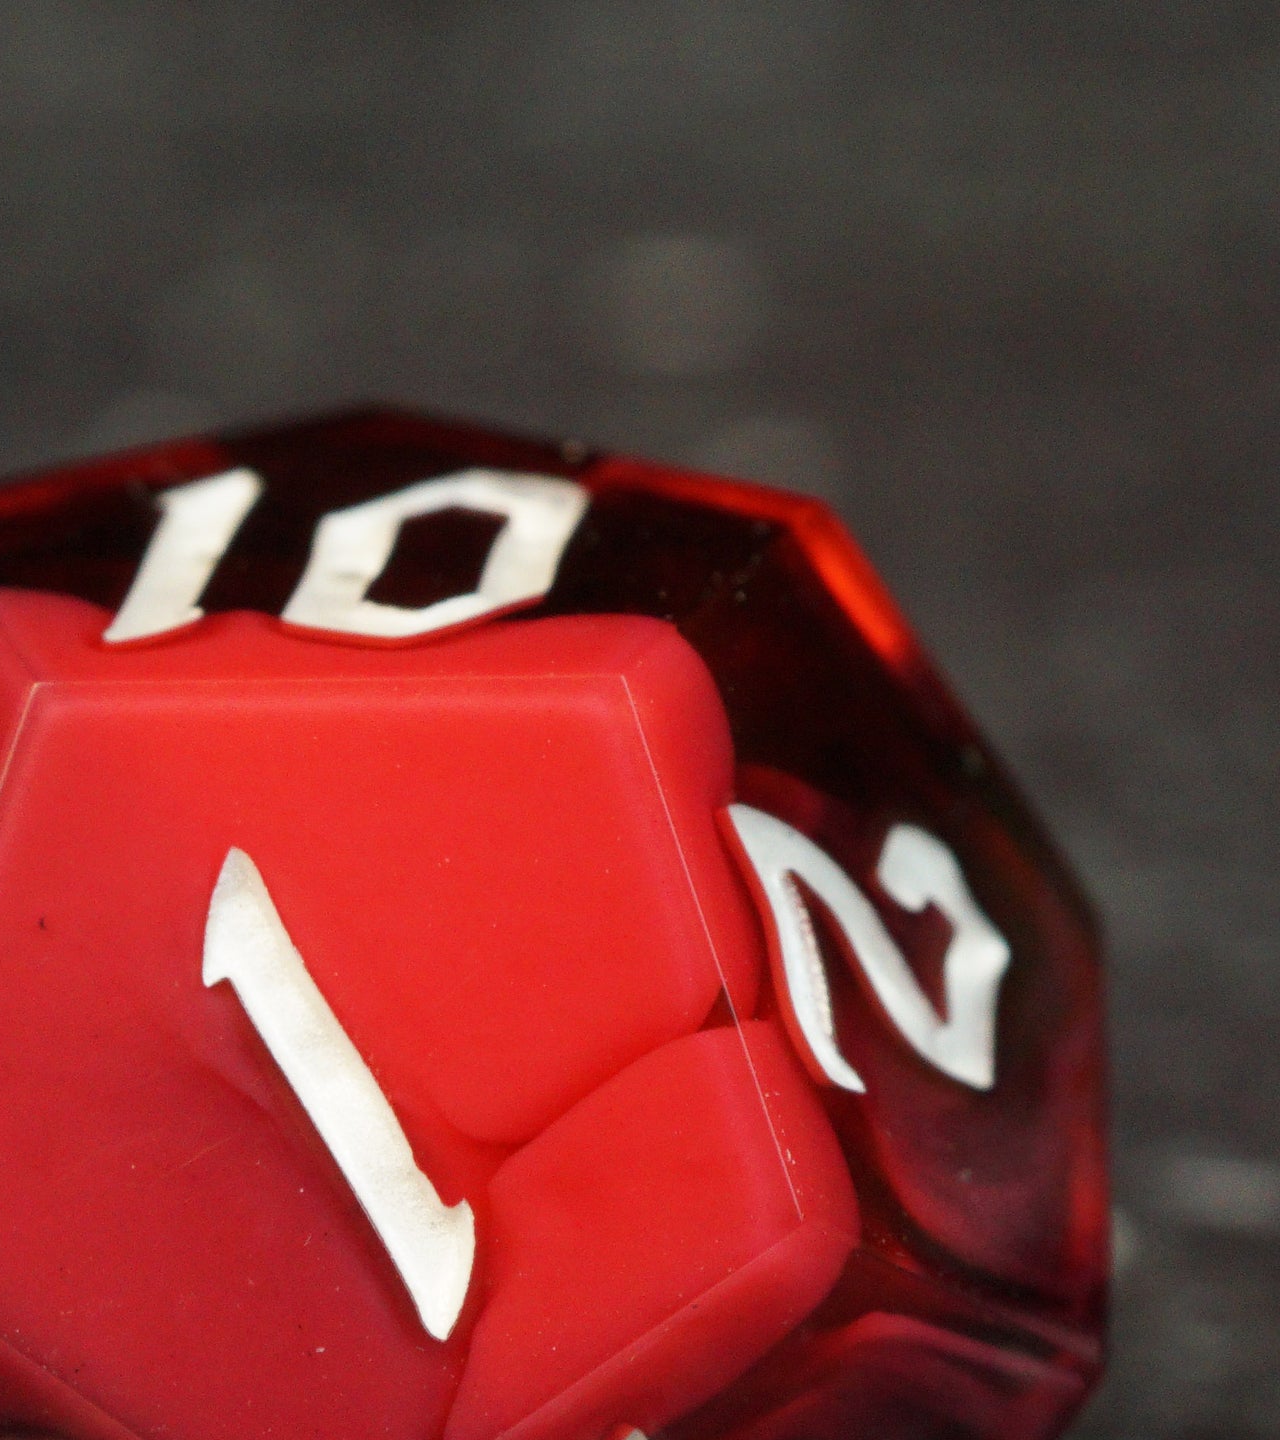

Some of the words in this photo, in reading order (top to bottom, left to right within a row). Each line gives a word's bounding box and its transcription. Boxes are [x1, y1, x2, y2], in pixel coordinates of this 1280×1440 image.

[102, 467, 592, 645] 10
[199, 843, 479, 1344] 1
[724, 801, 1013, 1095] 2
